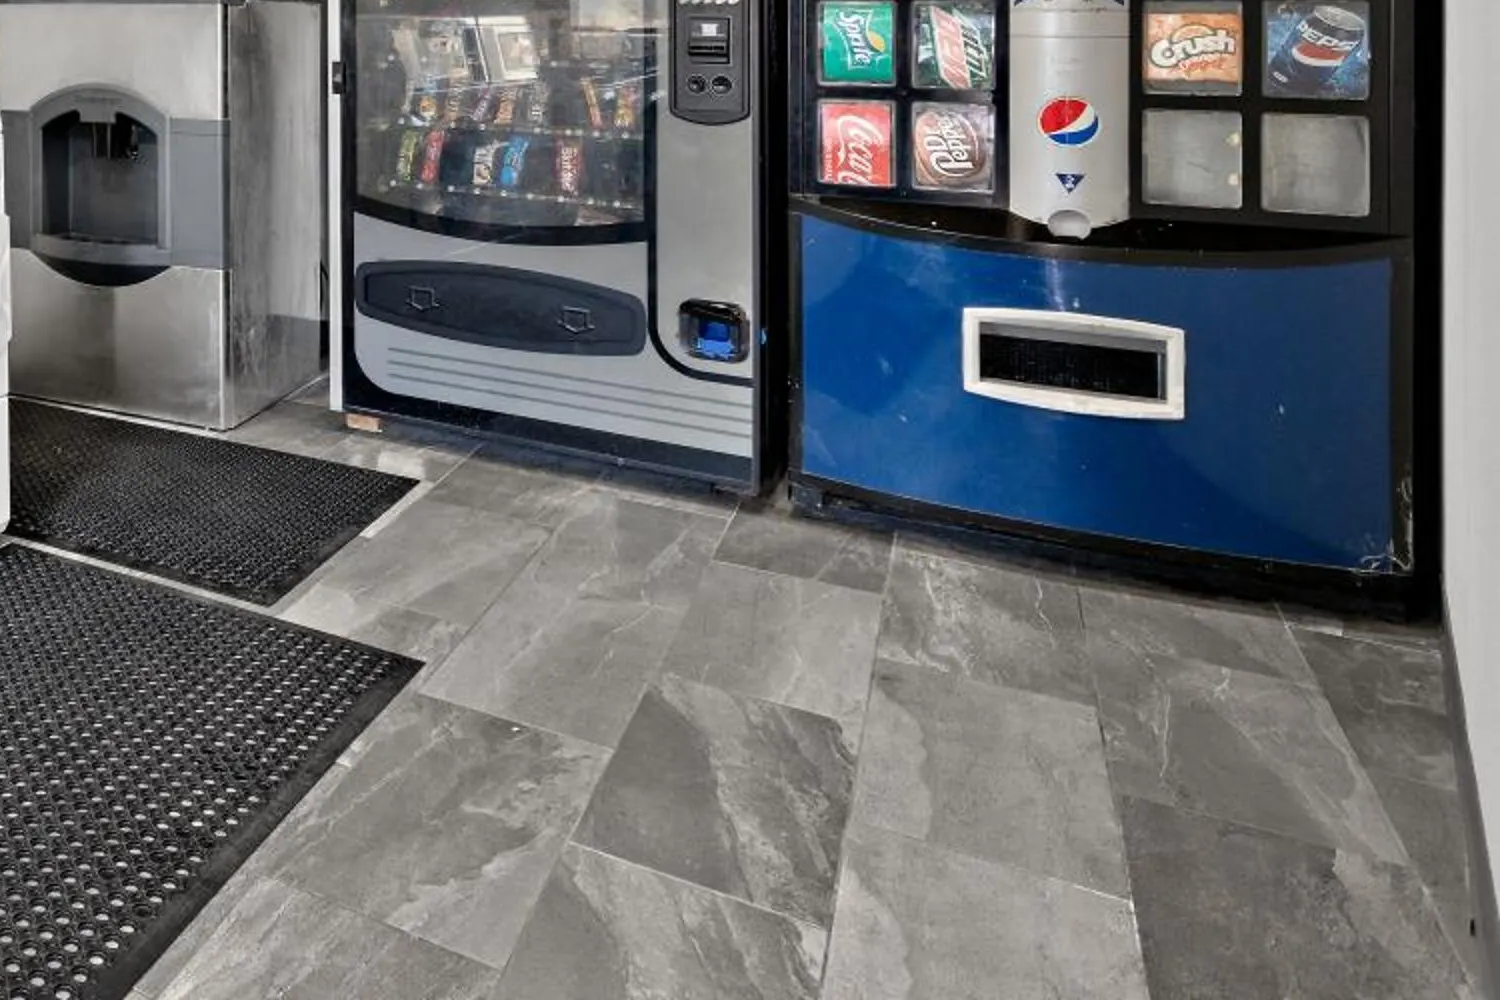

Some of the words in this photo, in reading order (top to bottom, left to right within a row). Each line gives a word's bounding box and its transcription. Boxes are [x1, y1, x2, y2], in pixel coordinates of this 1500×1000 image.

[837, 11, 874, 64] Sprite
[1151, 29, 1236, 68] Crush
[930, 115, 974, 175] Pepper
